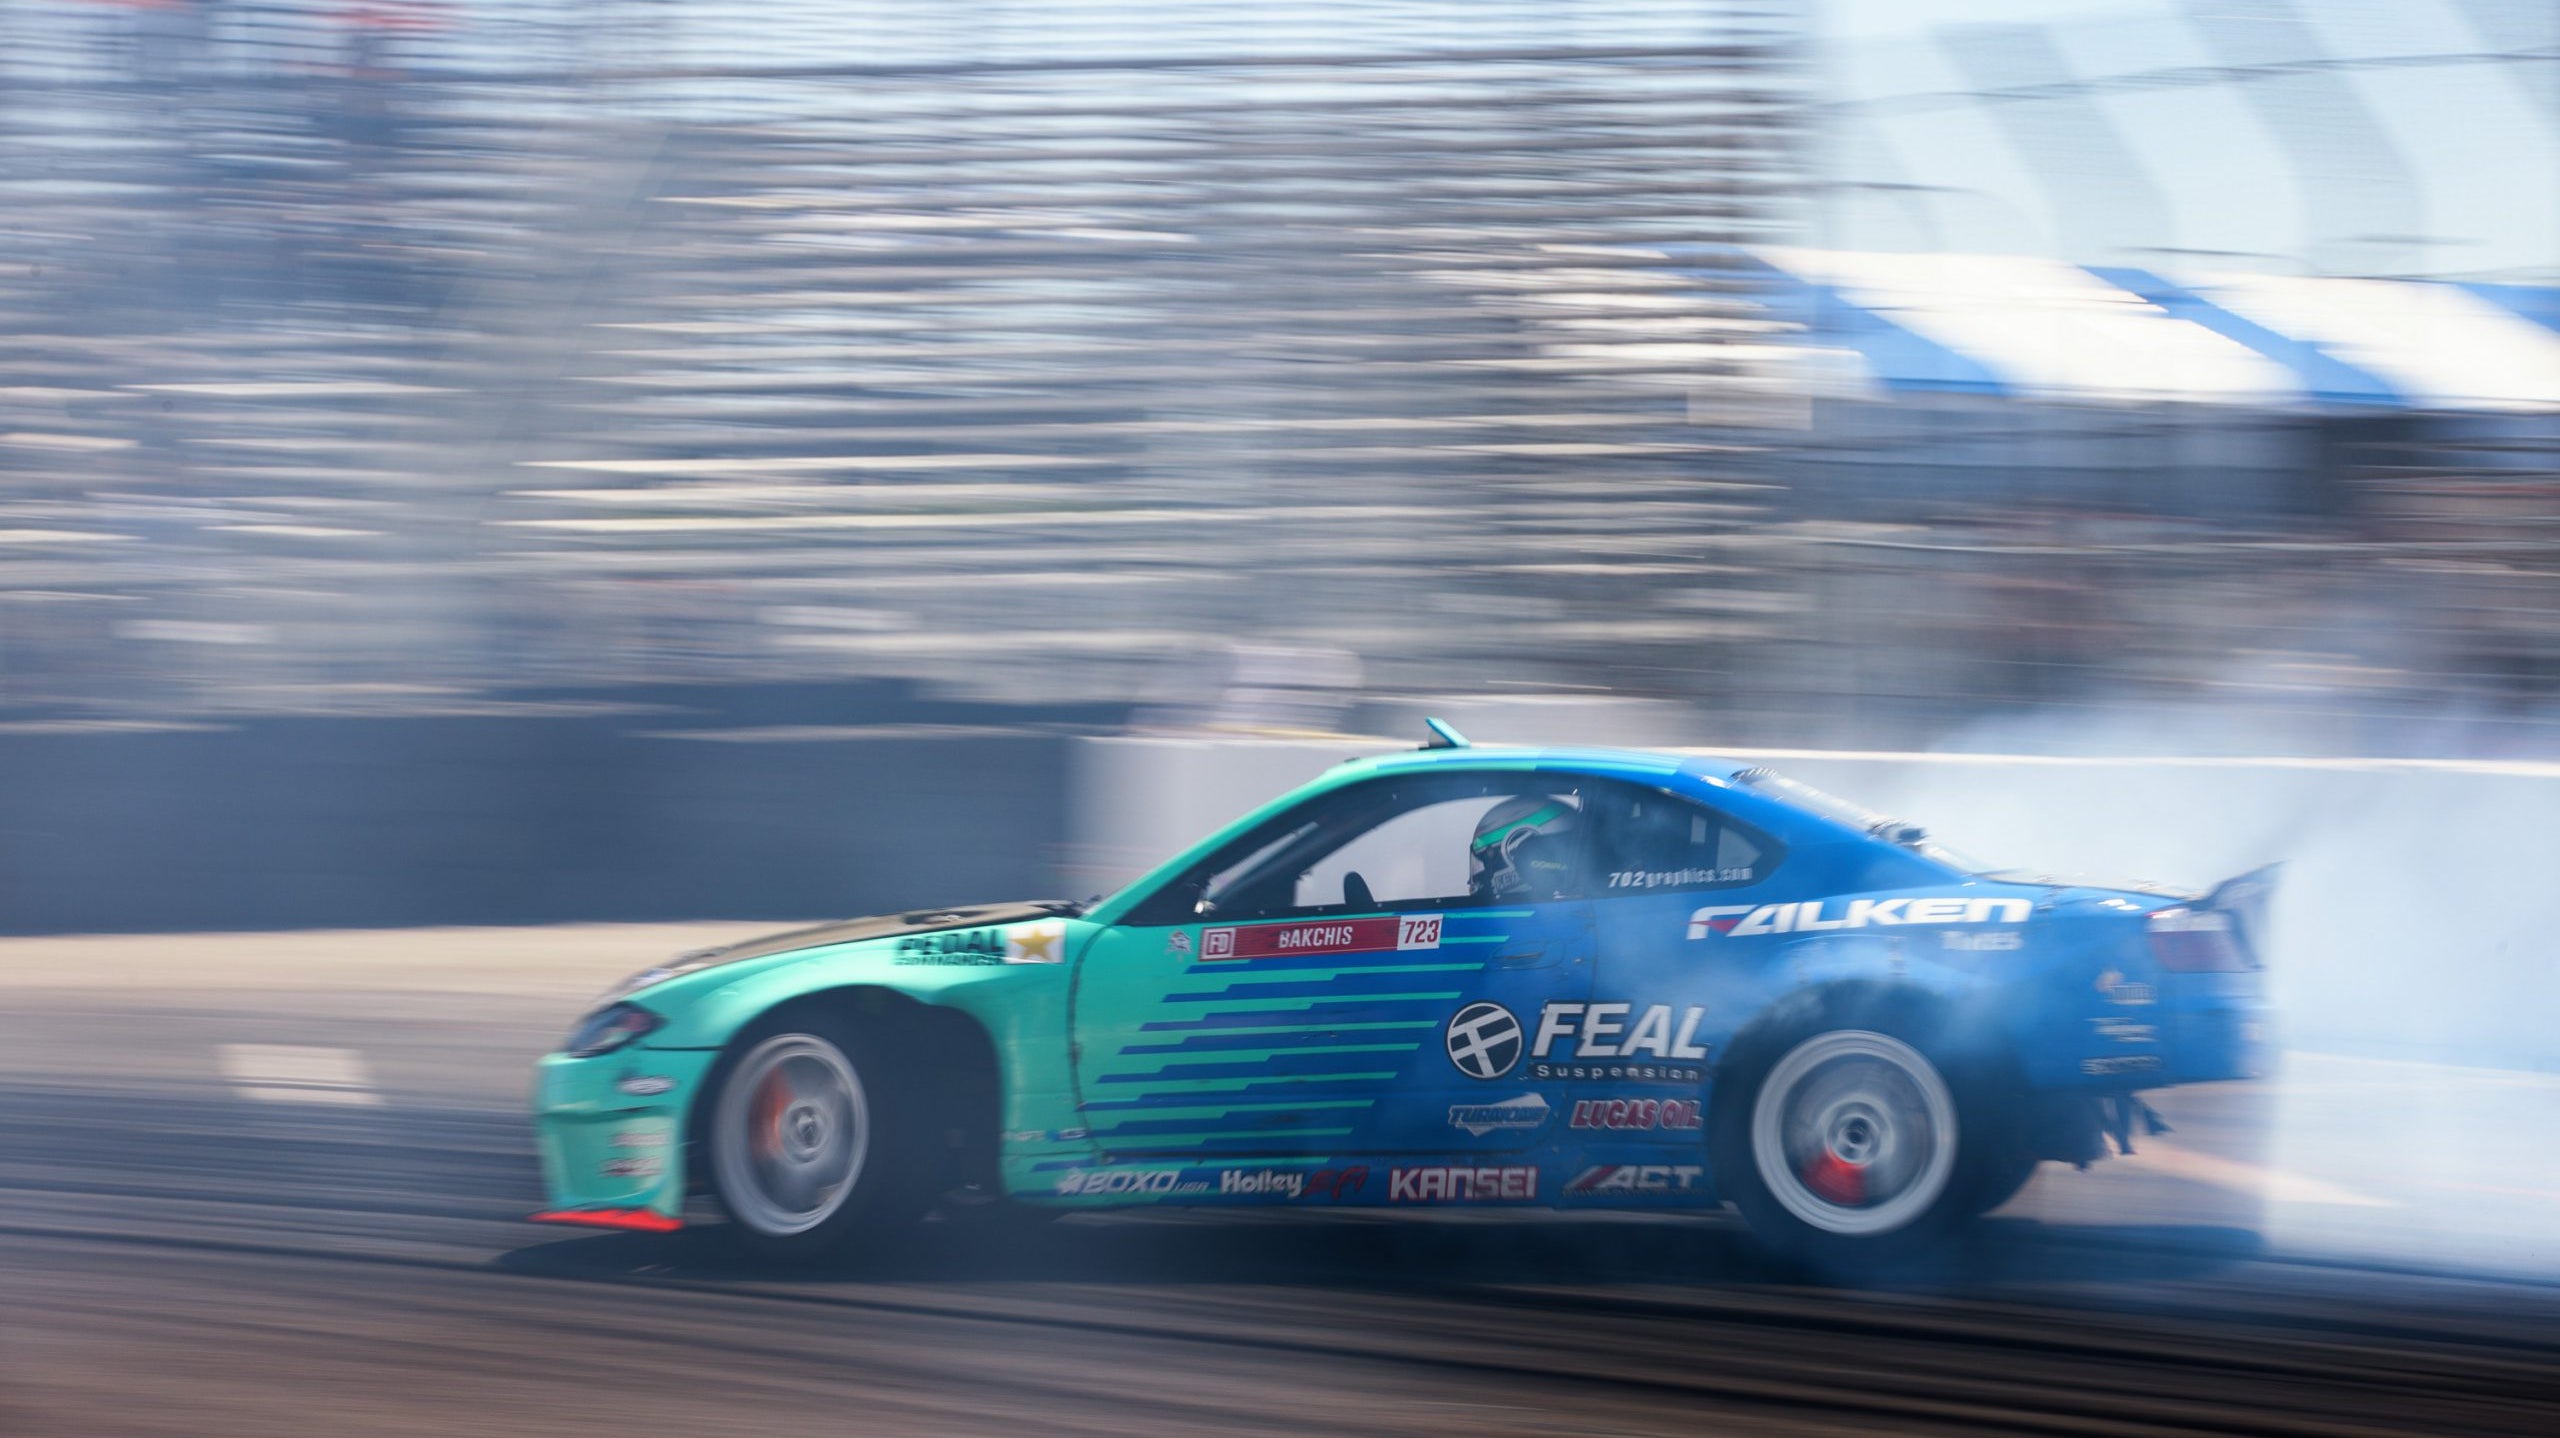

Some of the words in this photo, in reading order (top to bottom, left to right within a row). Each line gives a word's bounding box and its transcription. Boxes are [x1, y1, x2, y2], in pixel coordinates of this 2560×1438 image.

[1278, 926, 1354, 948] BAKCHIS
[1403, 919, 1440, 944] 723
[1686, 898, 2033, 940] FALKEN
[1532, 1002, 1708, 1060] FEAL
[1536, 1065, 1698, 1081] Suspension
[1570, 1099, 1658, 1130] LUCAS
[1660, 1099, 1704, 1130] OIL
[1081, 1171, 1179, 1194] BOXO
[1220, 1169, 1304, 1198] Holley
[1389, 1166, 1538, 1200] KANSEI
[1593, 1165, 1703, 1188] ACT
